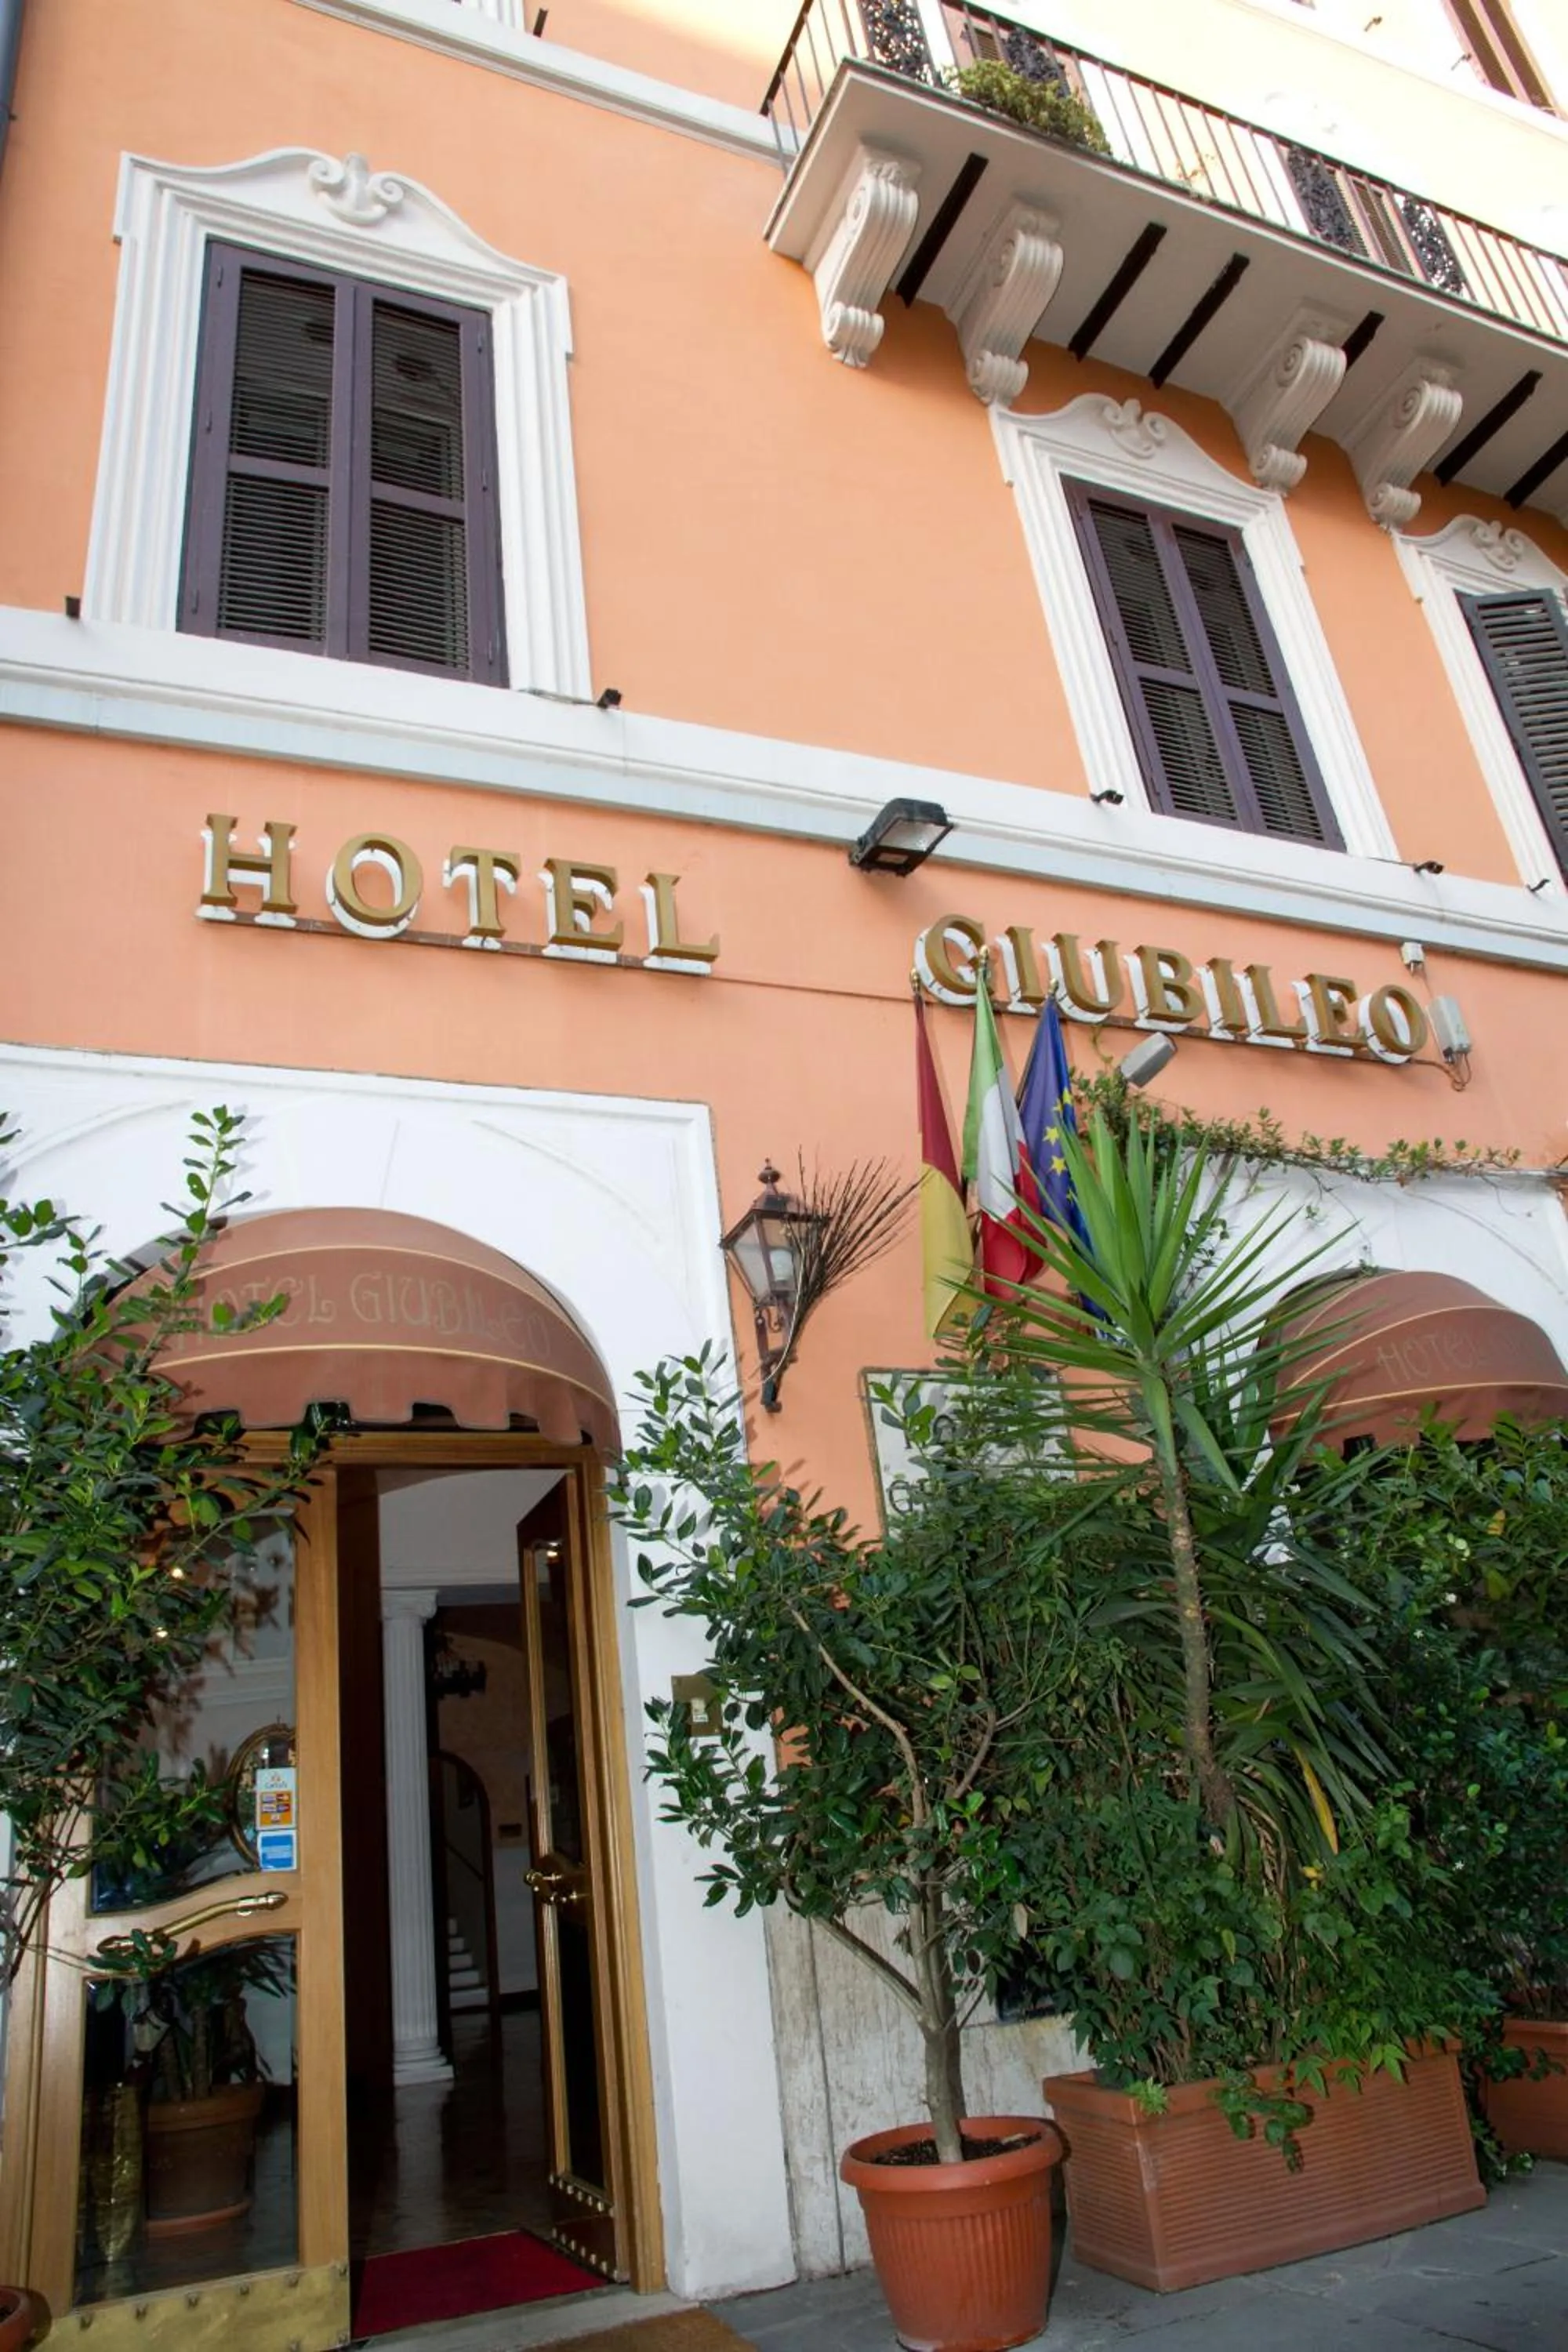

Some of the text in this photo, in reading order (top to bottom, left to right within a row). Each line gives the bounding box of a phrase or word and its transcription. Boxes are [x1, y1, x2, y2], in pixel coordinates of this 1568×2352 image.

[198, 813, 1426, 1062] HOTEL GIUBILEO
[350, 1272, 550, 1359] GIUBILEO
[1376, 1328, 1487, 1385] HOTEL
